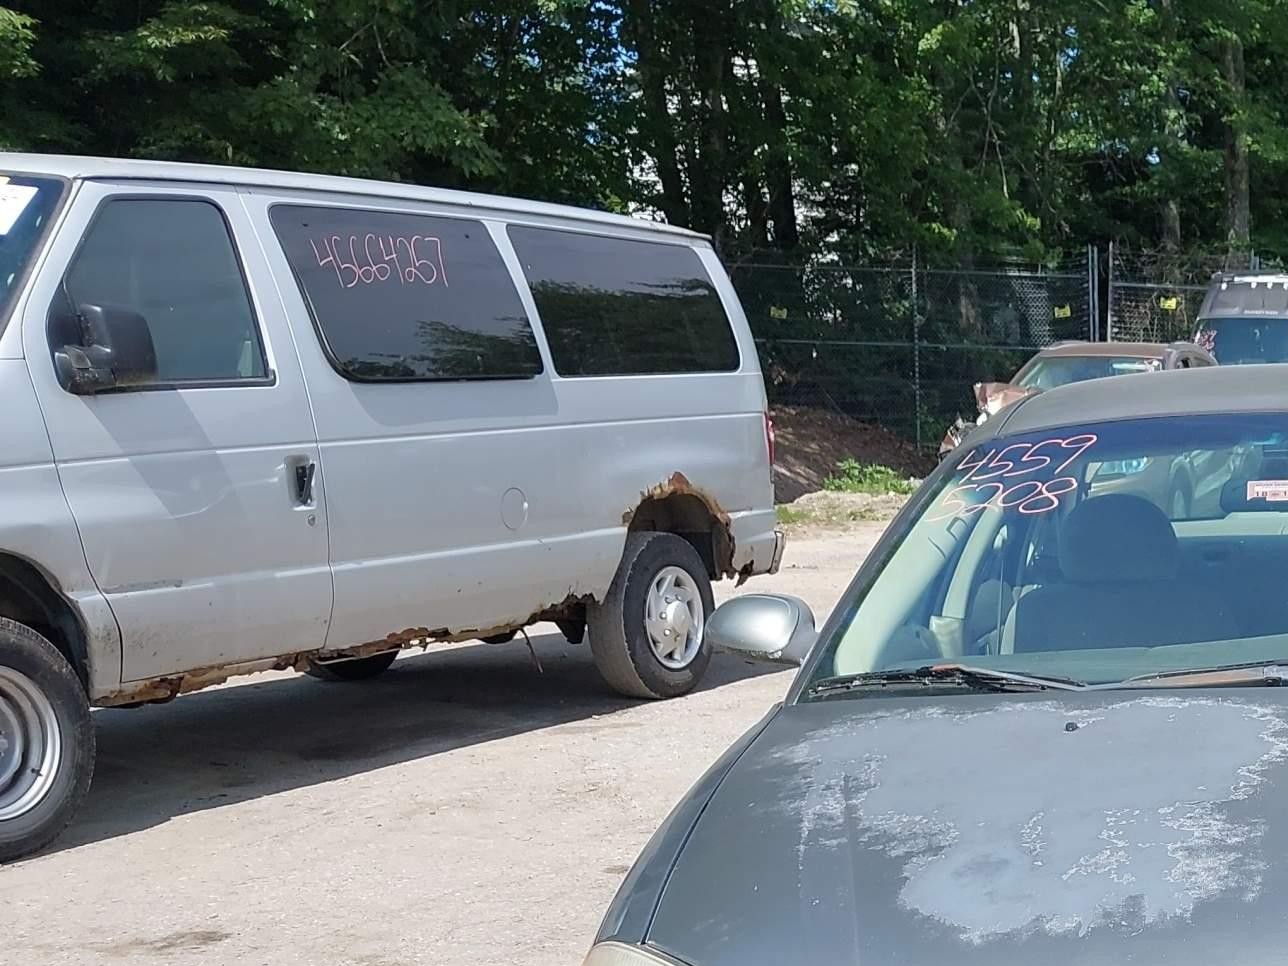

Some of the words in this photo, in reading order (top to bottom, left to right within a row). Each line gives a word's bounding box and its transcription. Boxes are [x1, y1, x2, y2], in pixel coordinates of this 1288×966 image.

[309, 233, 449, 288] 45664257
[956, 434, 1098, 485] 4559
[925, 477, 1078, 522] 5208
